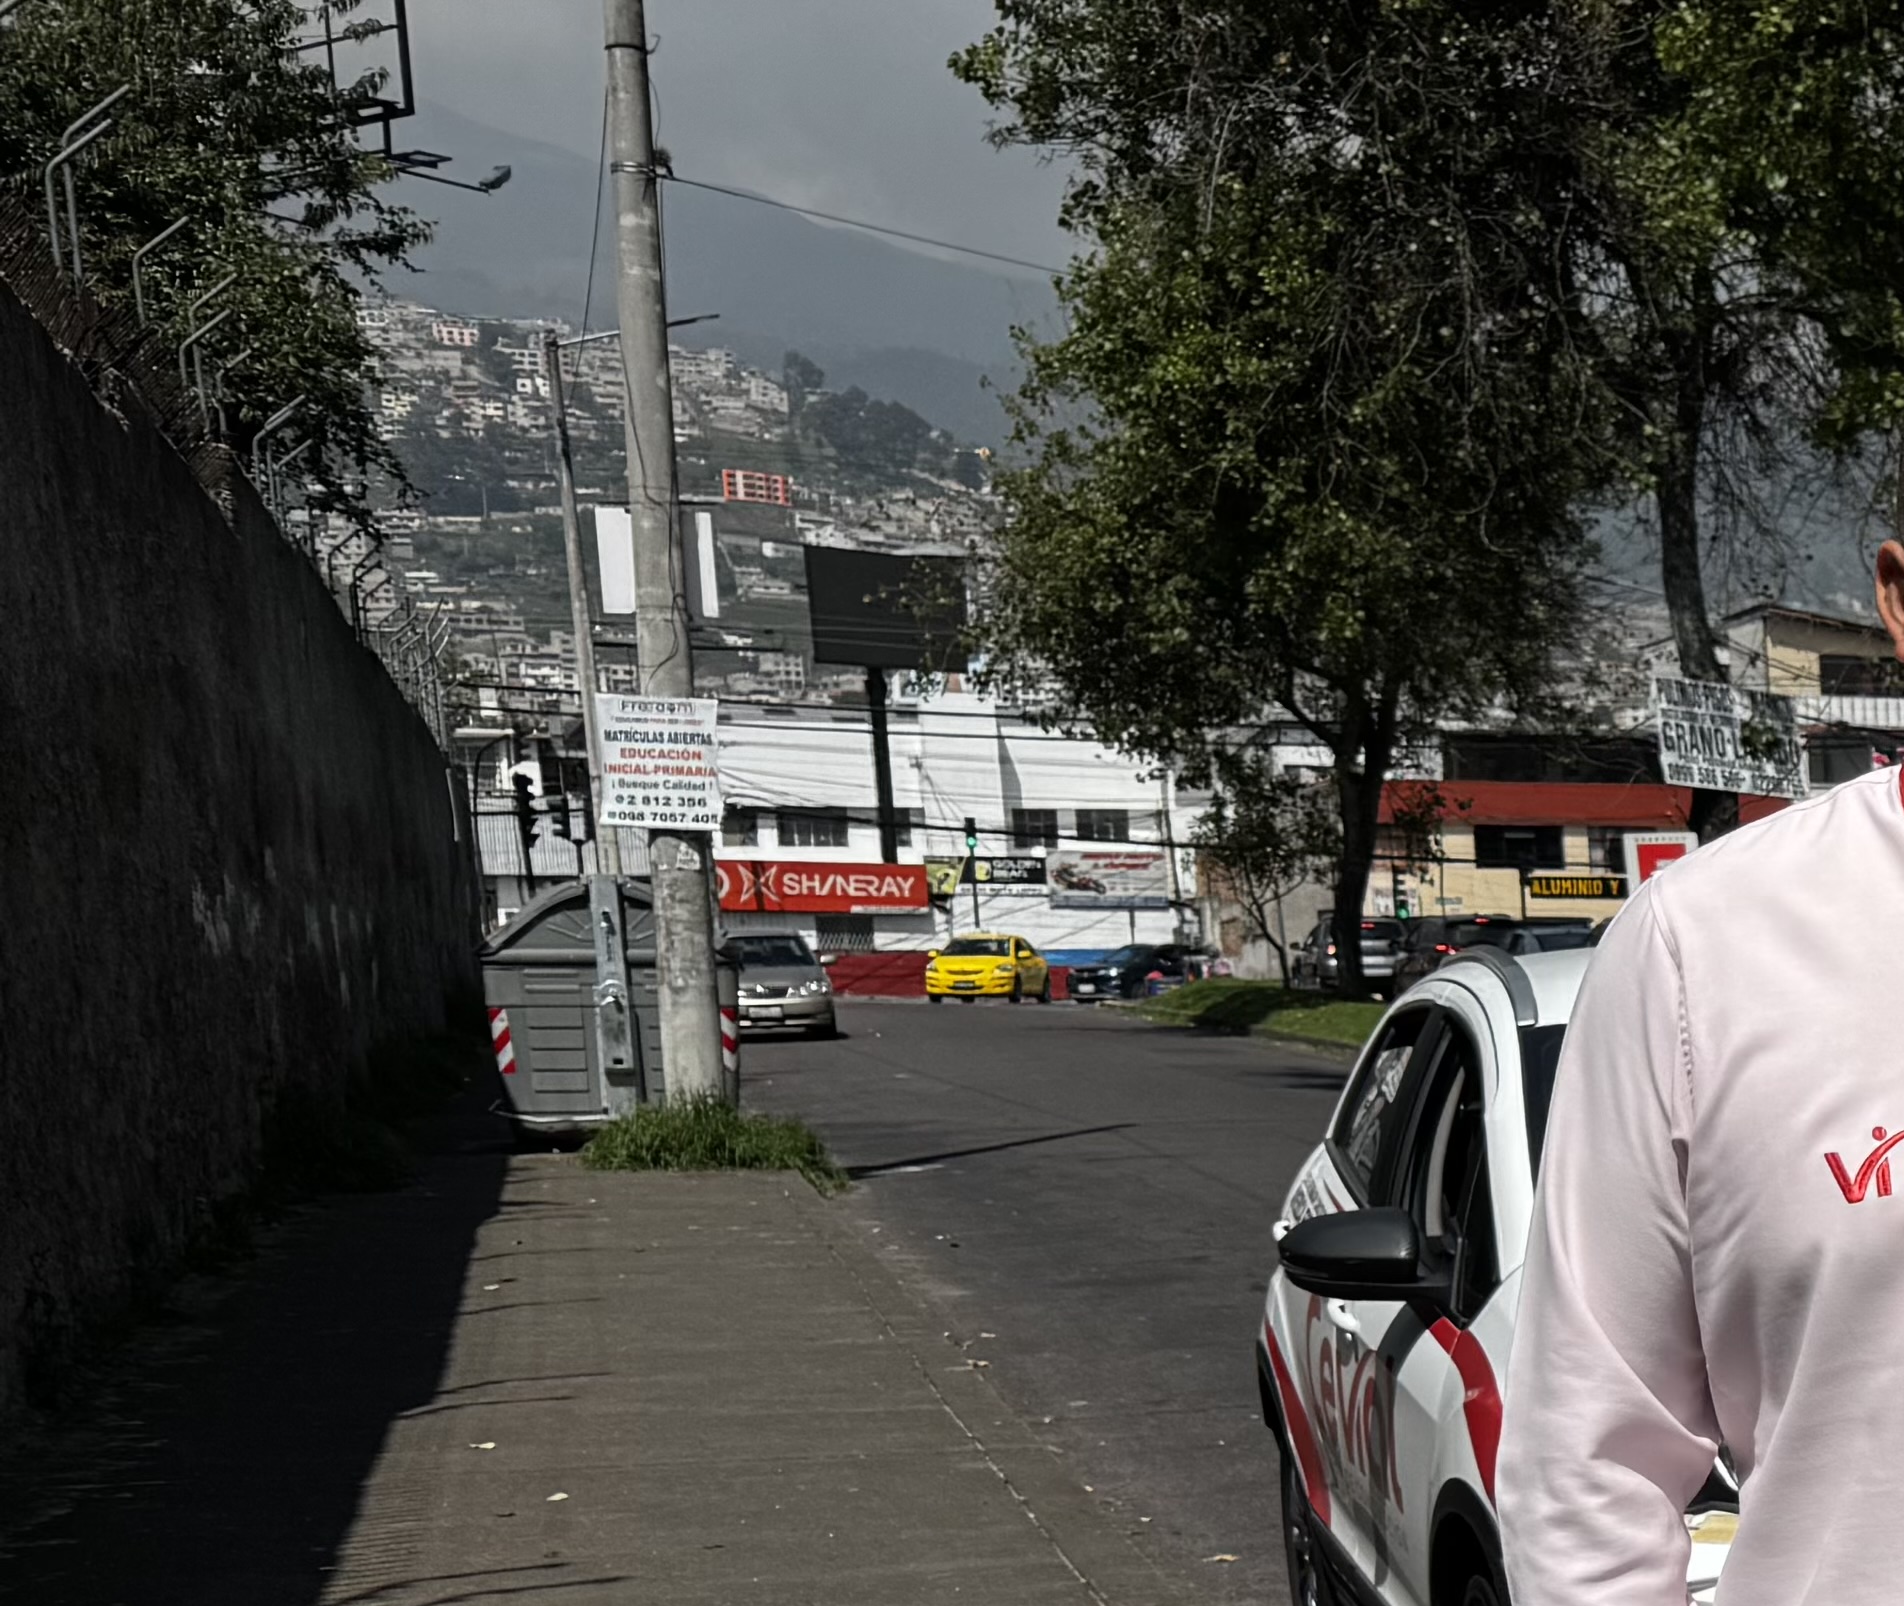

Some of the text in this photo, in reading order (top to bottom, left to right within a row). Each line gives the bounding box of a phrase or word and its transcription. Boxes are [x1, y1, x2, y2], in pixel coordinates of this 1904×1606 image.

[604, 727, 713, 746] MATRÍCULAS ABIERTAS
[620, 747, 702, 760] EDUCACIÓN
[782, 872, 915, 898] SHINERAY
[1532, 878, 1620, 896] ALUMINIO Y
